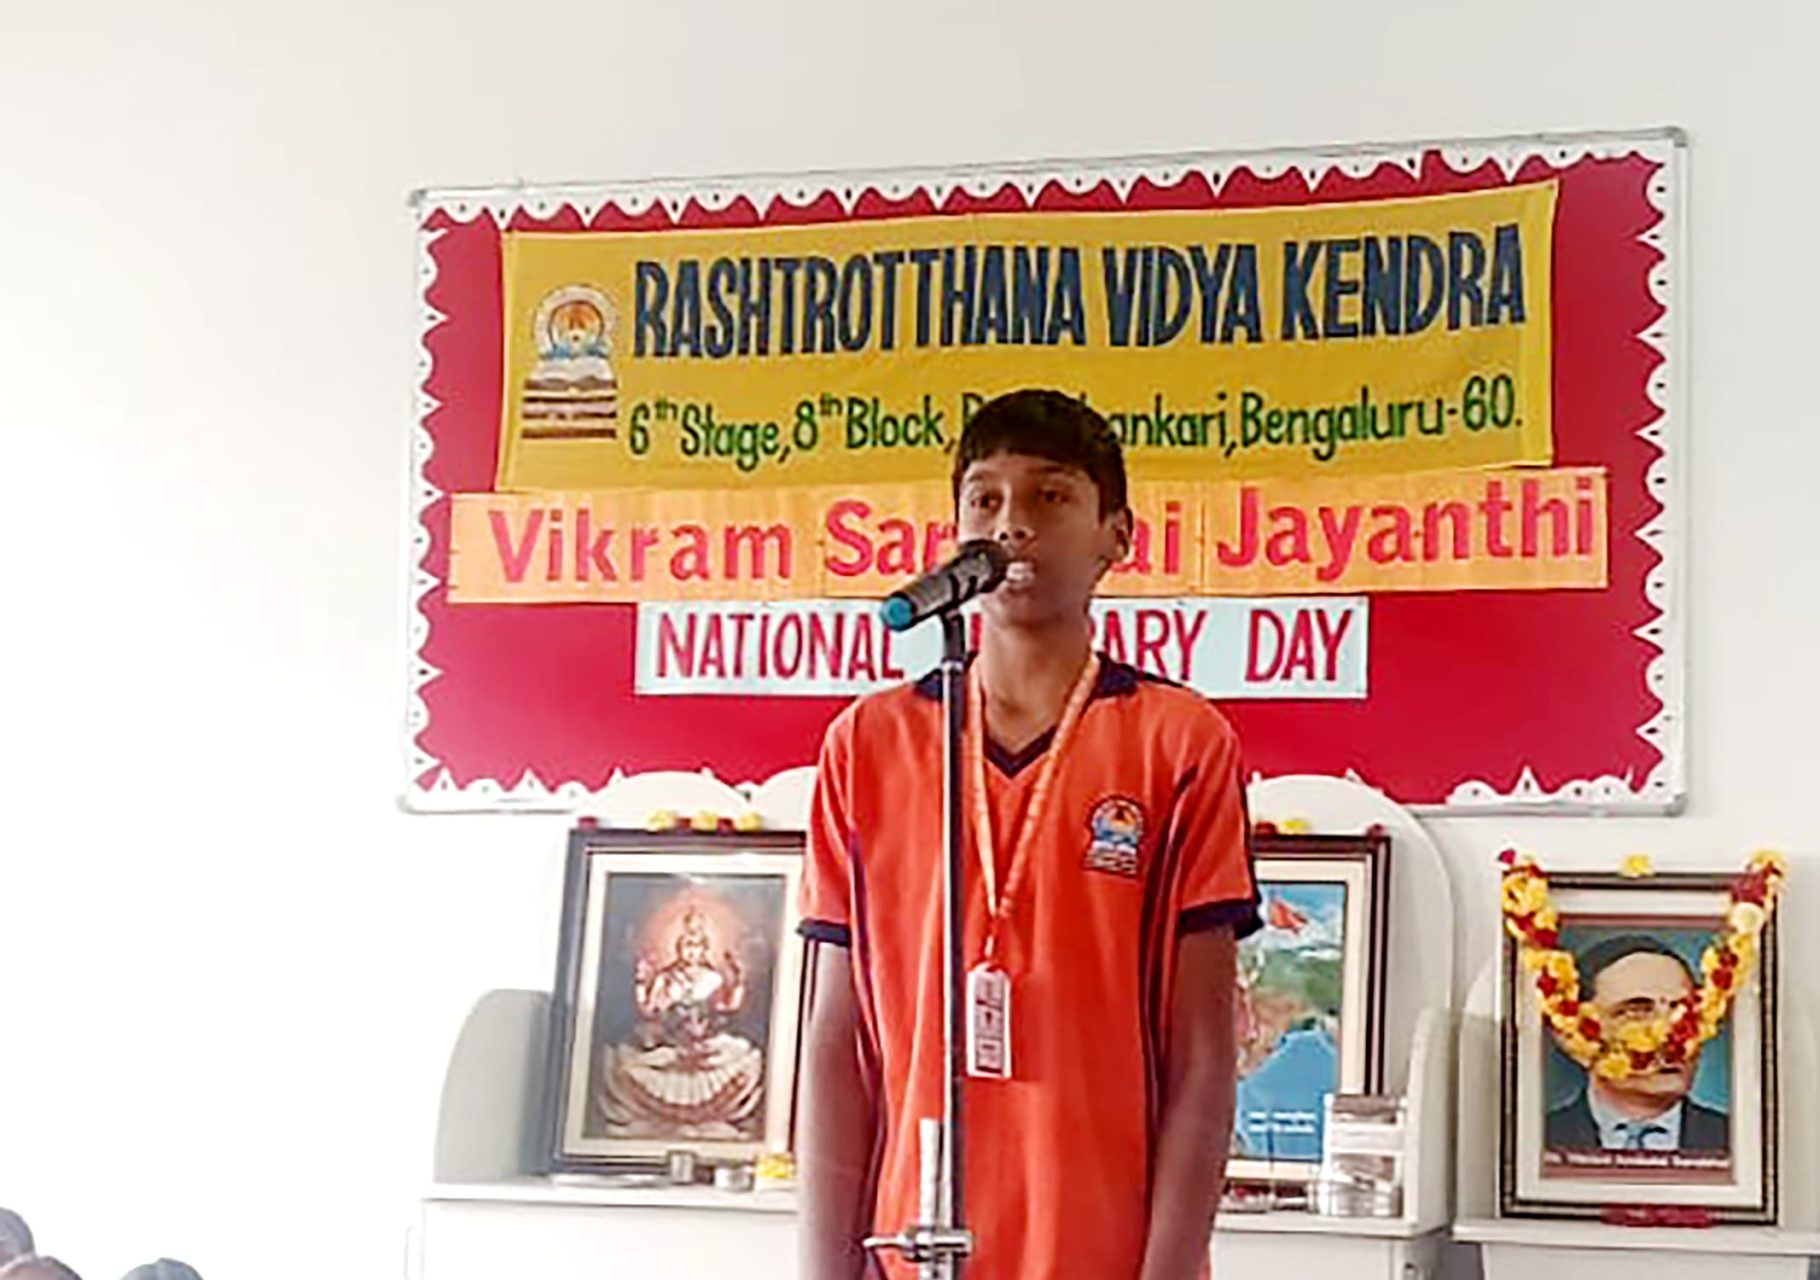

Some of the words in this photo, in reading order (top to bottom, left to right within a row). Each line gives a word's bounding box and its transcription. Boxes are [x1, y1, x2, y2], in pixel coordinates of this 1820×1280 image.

[634, 245, 1087, 358] RASHTROTTHANA
[1102, 242, 1263, 347] VIDYA
[1281, 223, 1526, 341] KENDRA
[630, 398, 678, 456] 6th
[680, 402, 791, 472] Stage,
[792, 392, 842, 451] 8th
[845, 394, 955, 454] Block,
[486, 505, 793, 586] Vikram
[824, 498, 1182, 577] Sarai
[1216, 476, 1594, 582] Jayanthi
[655, 609, 905, 681] NATIONAL
[1244, 608, 1352, 685] DAY
